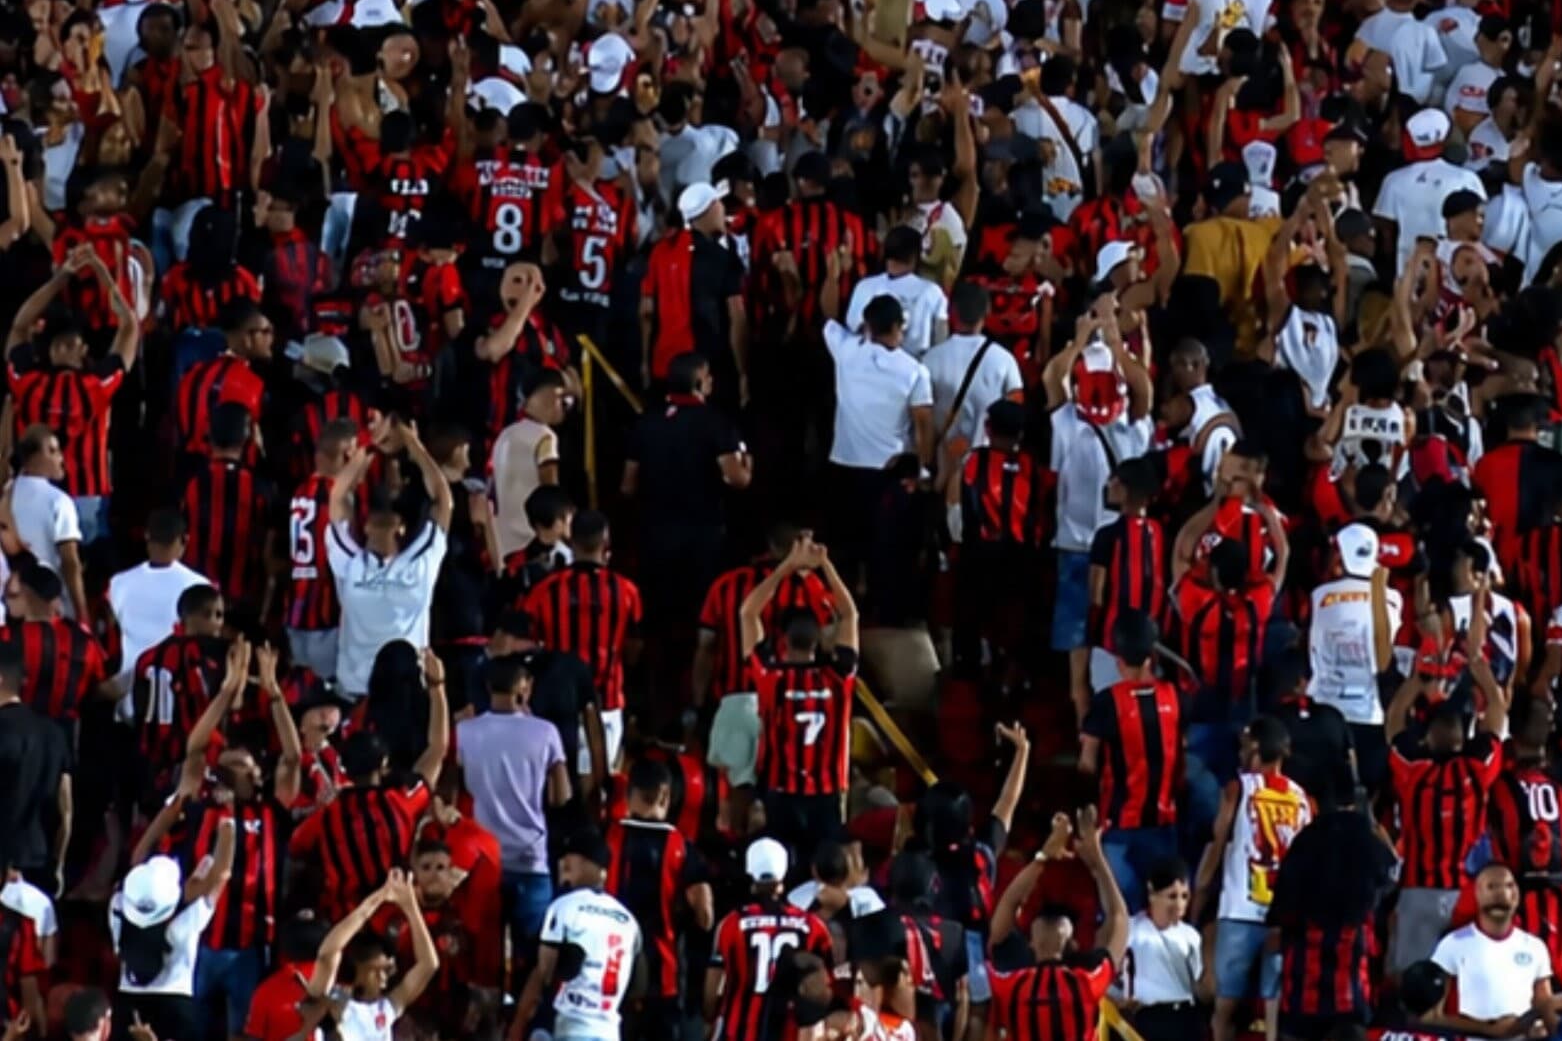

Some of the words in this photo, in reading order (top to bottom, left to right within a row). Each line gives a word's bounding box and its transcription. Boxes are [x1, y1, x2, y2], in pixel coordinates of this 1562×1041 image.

[492, 202, 524, 254] 8
[577, 235, 609, 290] 5
[793, 710, 827, 745] 7
[1517, 779, 1560, 823] 10
